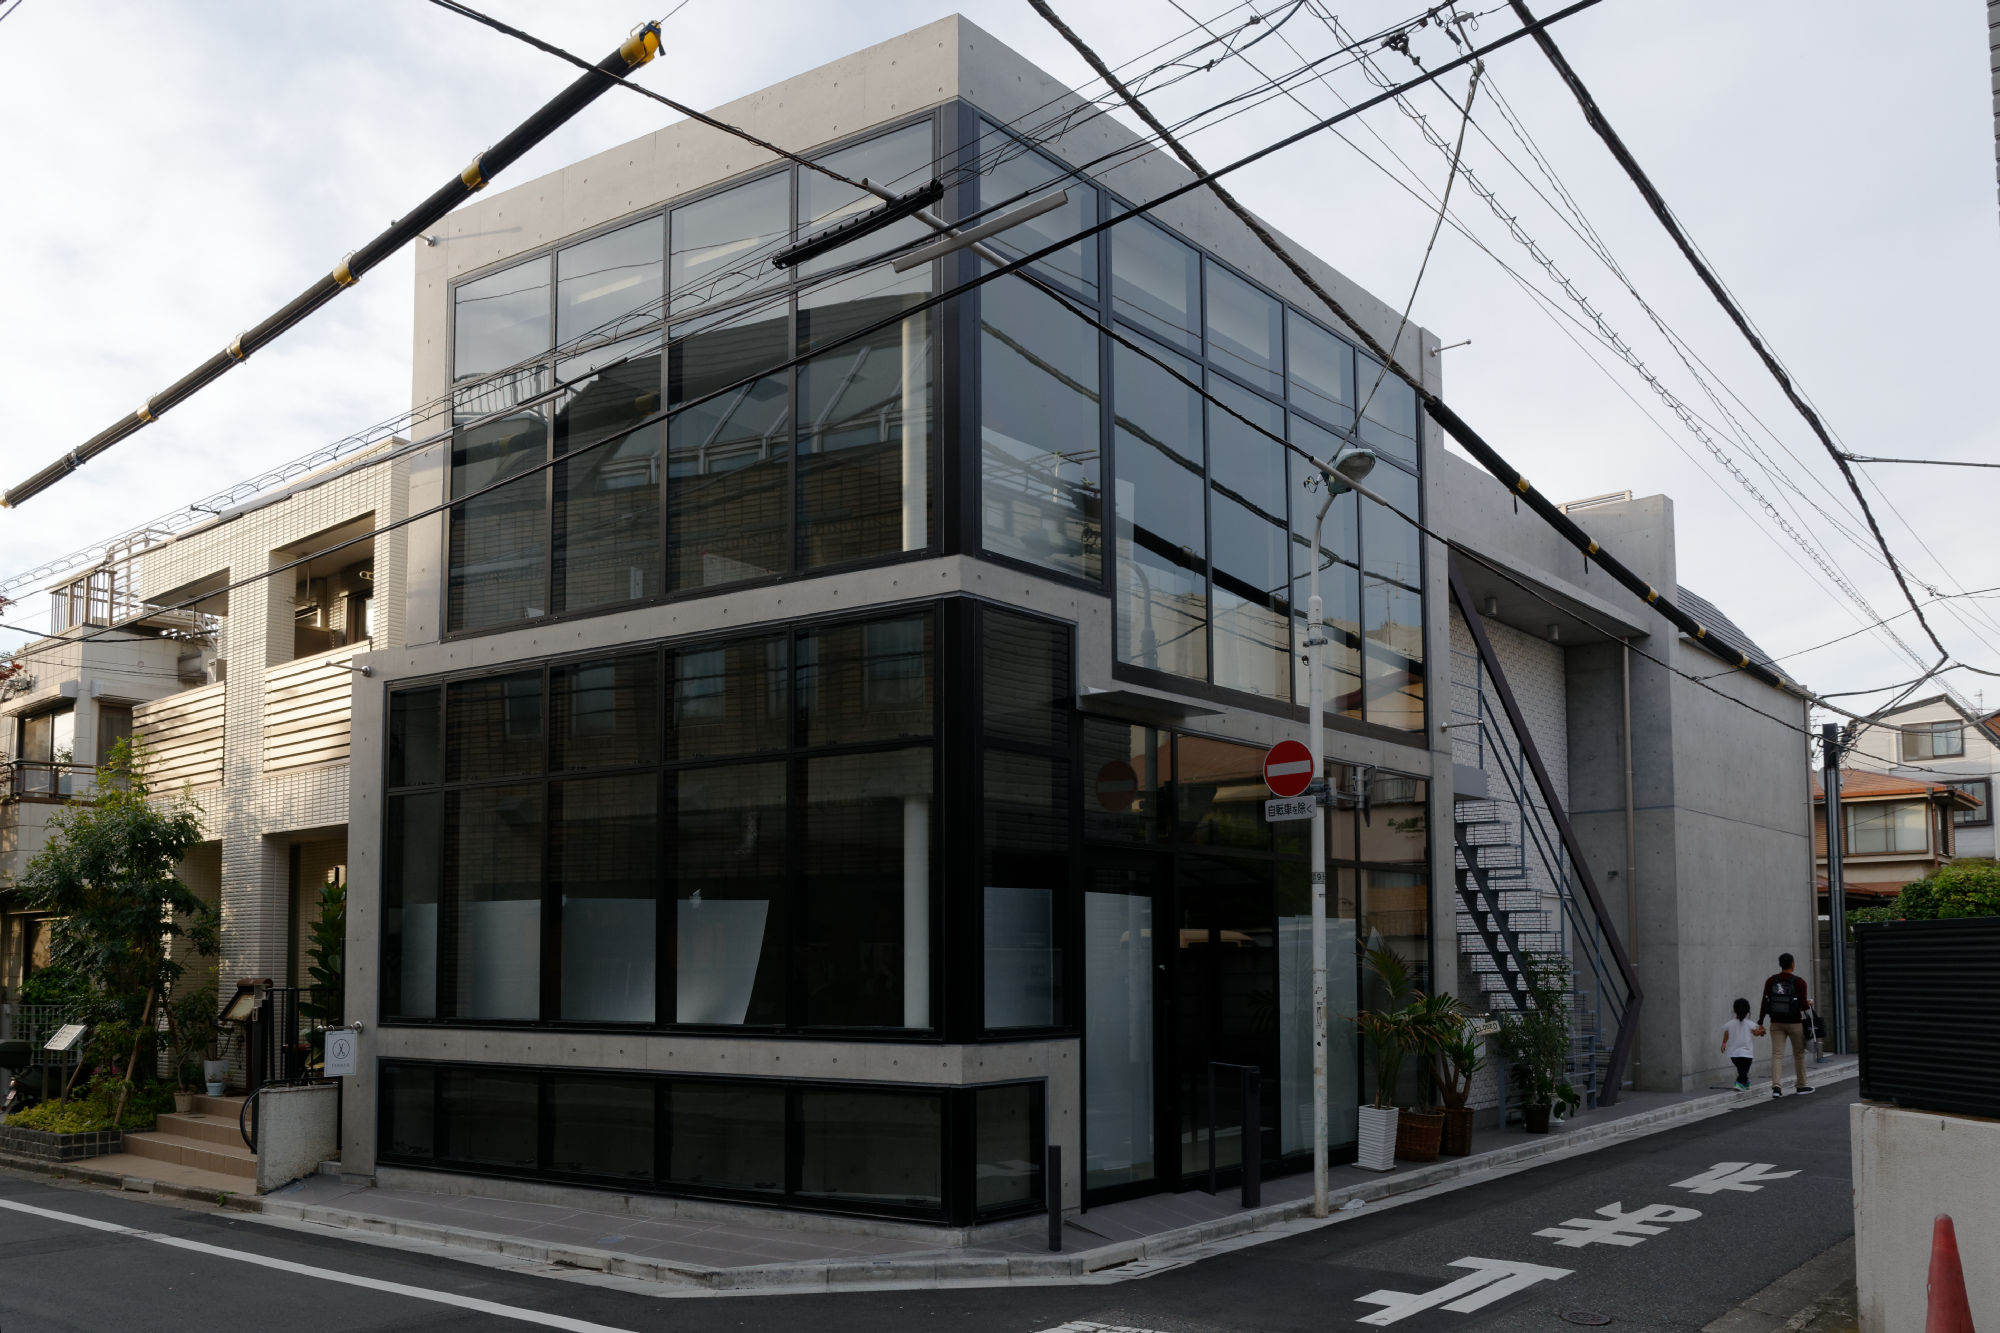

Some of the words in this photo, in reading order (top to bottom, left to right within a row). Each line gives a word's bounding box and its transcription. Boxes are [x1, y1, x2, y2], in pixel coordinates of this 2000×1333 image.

[1268, 802, 1312, 817] 自転車を除く
[1473, 1022, 1497, 1033] CLOSED
[1353, 1162, 1803, 1327] 止まれ
